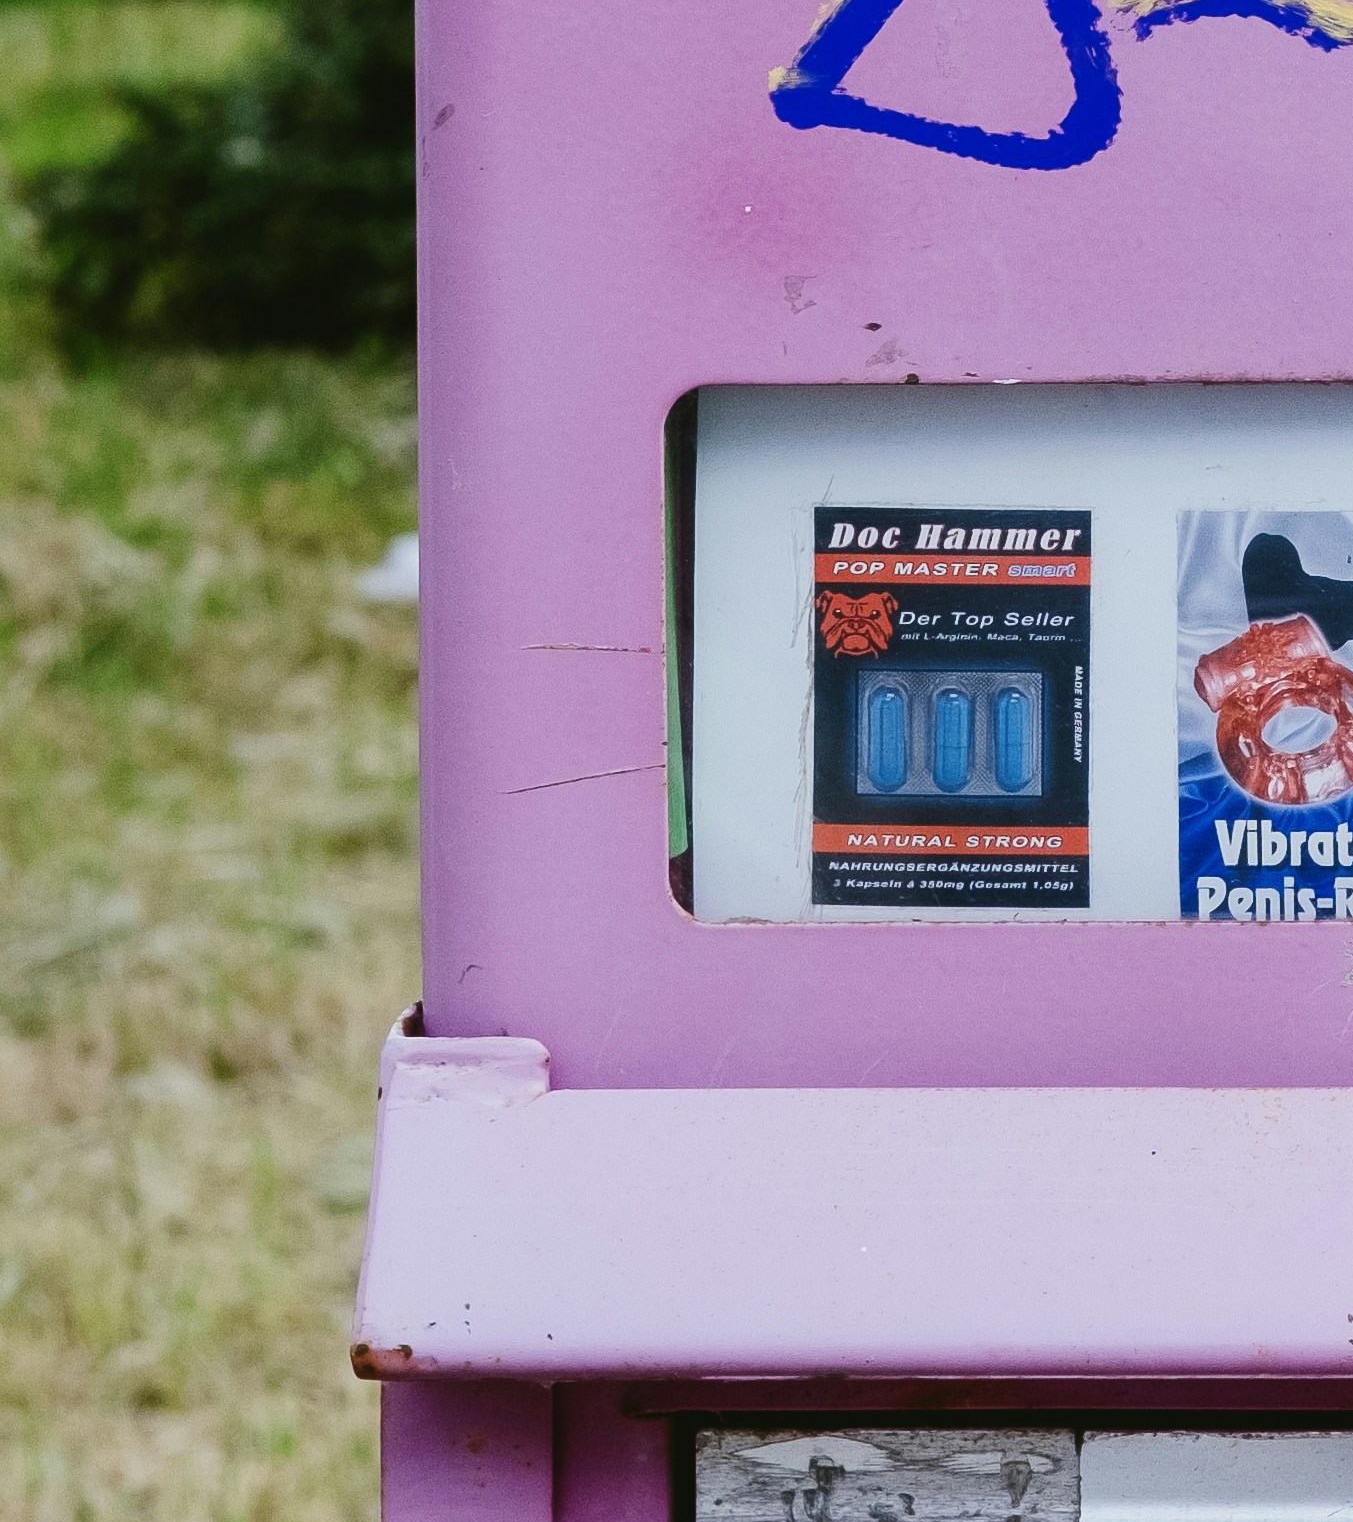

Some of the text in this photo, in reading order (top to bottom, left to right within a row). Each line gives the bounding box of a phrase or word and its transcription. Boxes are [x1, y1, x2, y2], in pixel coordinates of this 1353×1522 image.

[828, 522, 1082, 552] Doc Hammer
[832, 561, 1076, 578] POP MASTER smart
[899, 611, 1076, 629] Der Top Seller
[1073, 665, 1084, 763] MADE IN GERMANY
[847, 833, 1063, 849] NATURAL STRONG
[828, 860, 1079, 873] NAHRUNGSERGÄNZUNGSMITTEL
[846, 878, 902, 889] Kapseln
[969, 879, 1027, 891] (Gesamt
